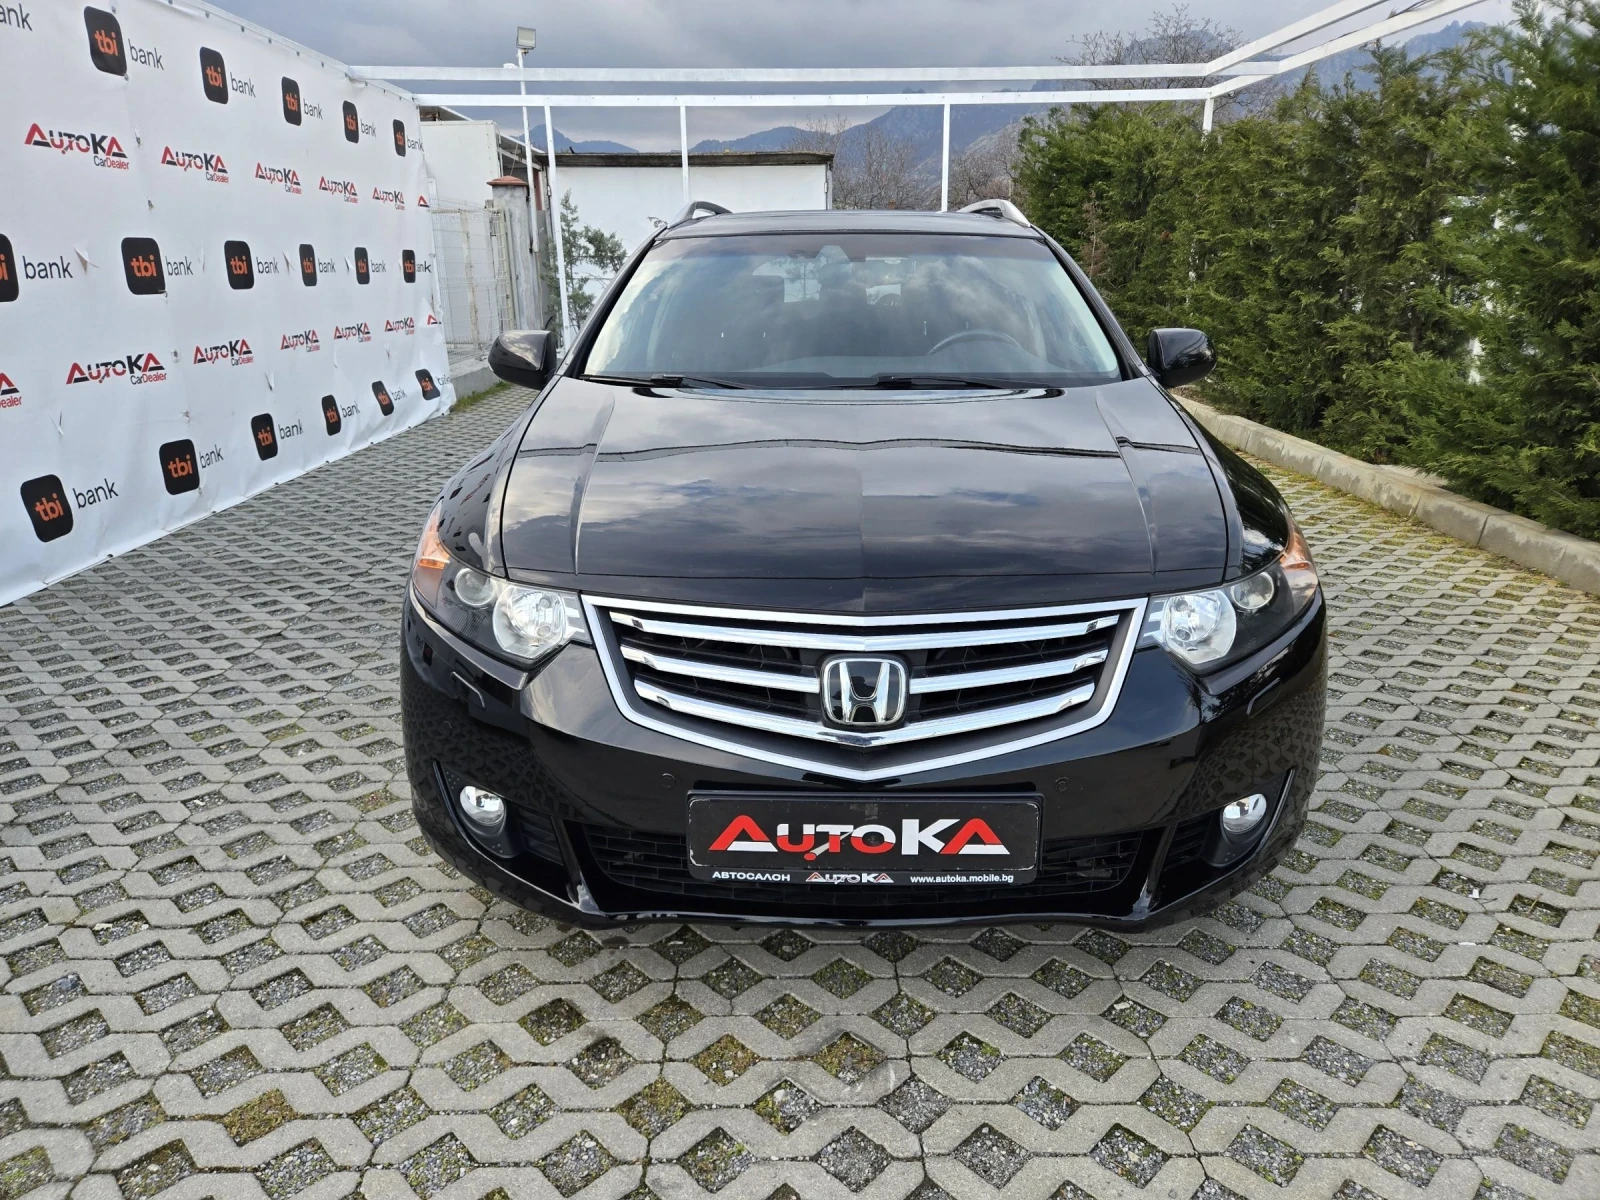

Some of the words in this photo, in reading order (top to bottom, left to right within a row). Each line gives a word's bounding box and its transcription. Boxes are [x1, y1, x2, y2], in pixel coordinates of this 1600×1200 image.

[0, 3, 33, 31] ank
[94, 30, 118, 56] tbi
[128, 39, 164, 70] bank
[206, 66, 223, 88] tbi
[230, 72, 256, 98] bank
[286, 93, 297, 111] tbi
[303, 98, 323, 120] bank
[346, 115, 356, 131] tbi
[360, 119, 377, 137] bank
[24, 122, 128, 158] AUTOKA
[407, 135, 424, 151] bank
[93, 155, 130, 170] CarDealer
[161, 146, 228, 174] AUTOKA
[23, 255, 73, 280] bank
[130, 255, 157, 277] tbi
[165, 256, 194, 276] bank
[230, 256, 248, 275] tbi
[256, 257, 279, 274] bank
[303, 257, 314, 274] tbi
[318, 258, 336, 273] bank
[357, 258, 367, 273] tbi
[371, 259, 387, 274] bank
[416, 260, 432, 273] ank
[193, 338, 253, 364] AUTOKA
[66, 352, 165, 385] AUTOKA
[130, 372, 167, 385] CarDealer
[0, 396, 22, 408] ealer
[326, 406, 338, 423] tbi
[258, 426, 273, 446] tbi
[278, 419, 303, 440] bank
[168, 454, 193, 478] tbi
[199, 444, 224, 468] bank
[35, 493, 64, 521] tbi
[72, 478, 119, 509] bank
[708, 815, 1010, 861] AUTOKA
[712, 871, 791, 882] АВТОСАЛОН
[805, 871, 894, 884] AUTOKA
[910, 874, 1014, 884] www.autoka.mobile.bg
